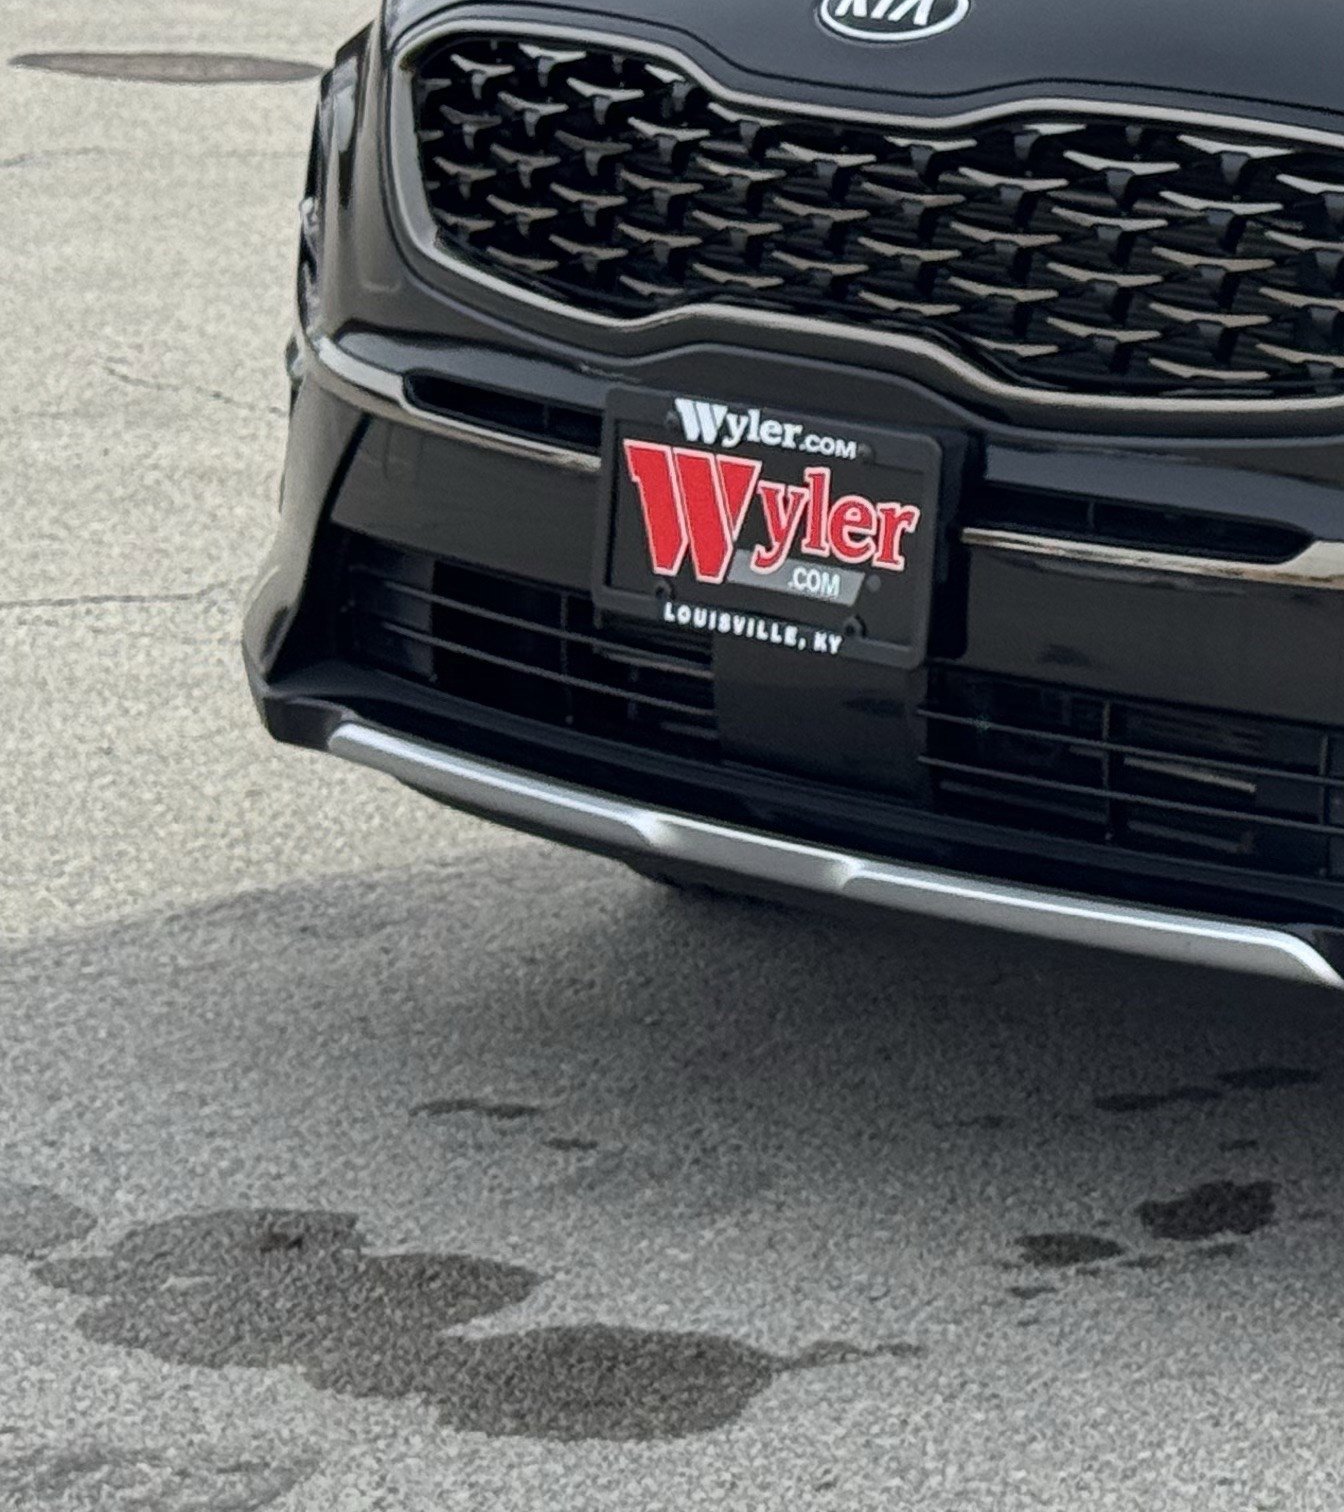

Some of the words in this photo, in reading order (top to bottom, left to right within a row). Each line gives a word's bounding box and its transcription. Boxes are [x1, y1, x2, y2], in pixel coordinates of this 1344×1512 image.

[622, 438, 921, 584] Wyler
[663, 602, 806, 651] LOUISVILLE,
[813, 631, 843, 655] KY
